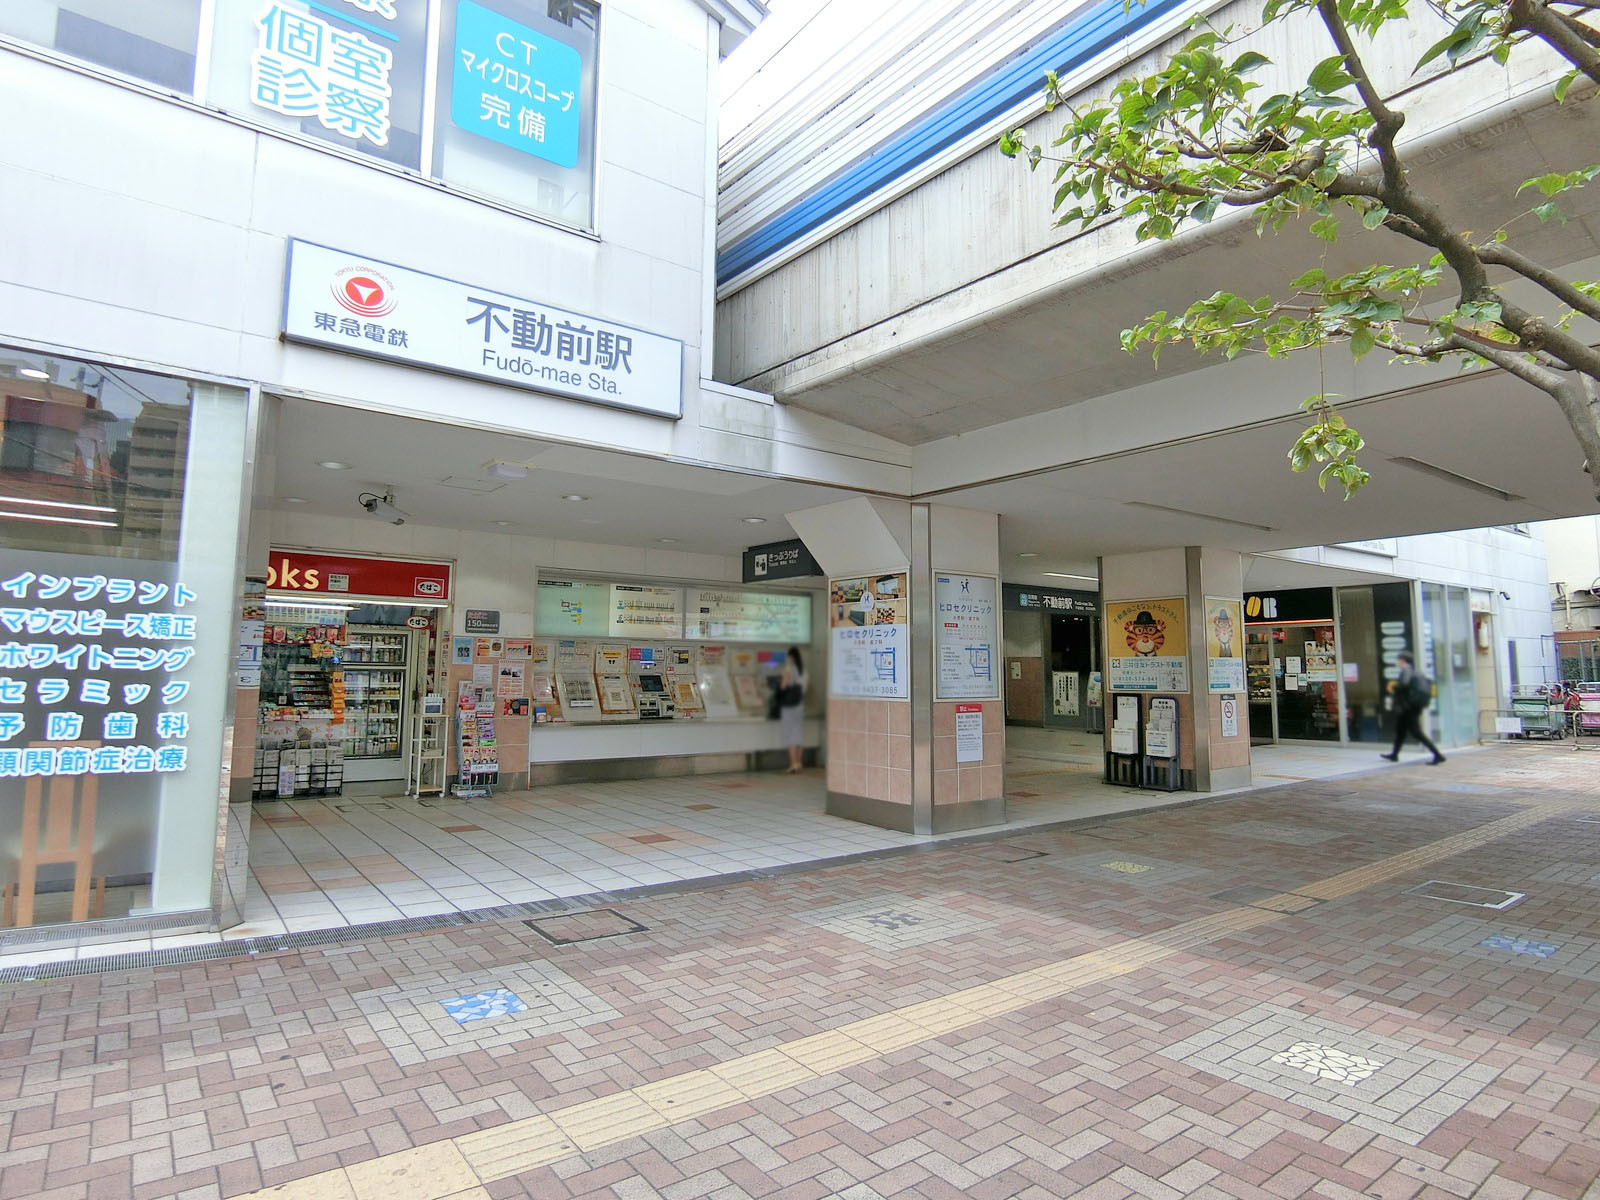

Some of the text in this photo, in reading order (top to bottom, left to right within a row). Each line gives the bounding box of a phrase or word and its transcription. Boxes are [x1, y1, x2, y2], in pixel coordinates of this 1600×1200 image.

[259, 4, 388, 92] 個室
[495, 32, 538, 65] CT
[460, 48, 576, 112] マイクロスコープ
[256, 55, 384, 140] 診察
[479, 92, 547, 143] 完備
[313, 311, 408, 348] 東急電鉄
[465, 296, 633, 375] 不動前駅
[482, 348, 622, 395] Fudō-mae Sta.
[2, 572, 197, 606] インプラント
[419, 583, 439, 592] たばこ
[0, 608, 197, 639] マウスピース矯正
[1243, 596, 1278, 618] OR
[0, 642, 195, 671] ホワイトニング
[0, 678, 190, 704] セラミック
[0, 712, 190, 741] 予防歯科
